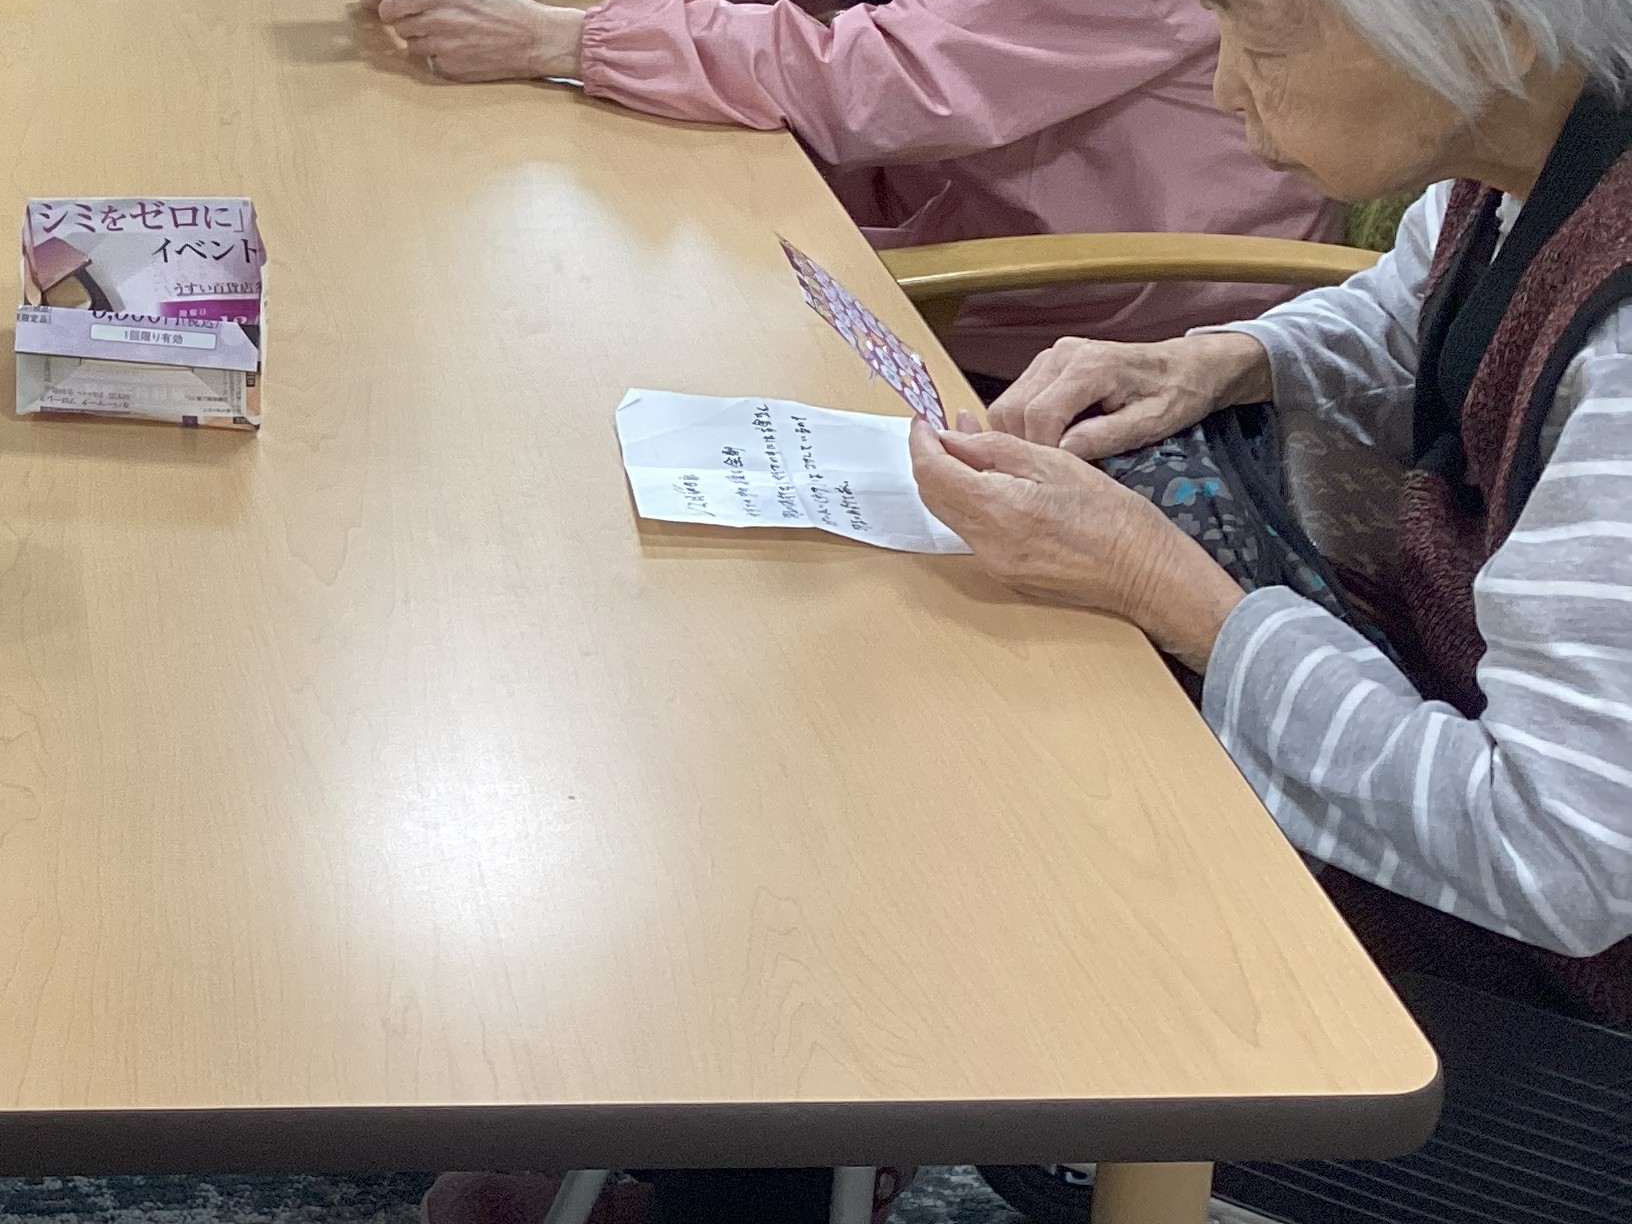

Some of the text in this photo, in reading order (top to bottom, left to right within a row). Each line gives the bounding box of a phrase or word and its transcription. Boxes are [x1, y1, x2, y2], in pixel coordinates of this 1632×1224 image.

[152, 237, 257, 264] イベント
[124, 330, 184, 345] 1回限り有効
